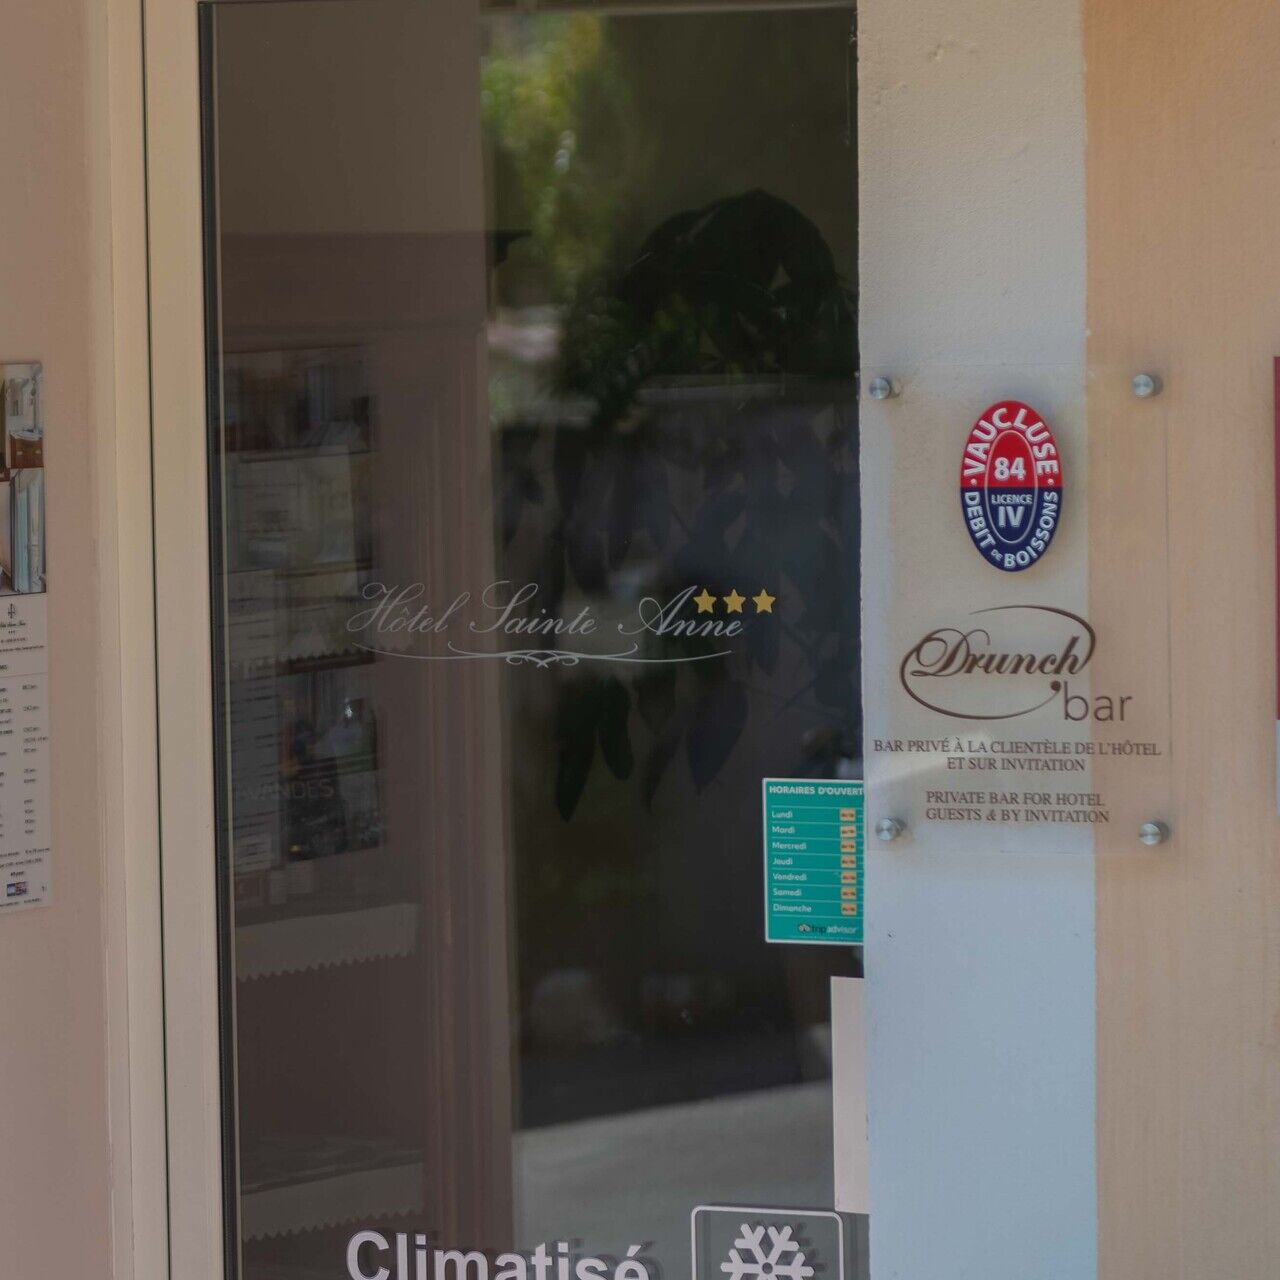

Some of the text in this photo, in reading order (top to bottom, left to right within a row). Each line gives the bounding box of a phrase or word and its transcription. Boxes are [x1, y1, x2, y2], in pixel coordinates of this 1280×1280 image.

[963, 408, 1060, 477] VAUCLUSE
[994, 457, 1027, 481] 84
[991, 494, 1033, 505] LICENCE
[998, 506, 1025, 528] IV
[964, 491, 1059, 569] DEBIT DE BOISSONS
[347, 581, 745, 637] Hôtel Sainte Anne
[910, 628, 1081, 677] Drunch
[1064, 681, 1133, 721] bar
[874, 737, 1161, 756] BAR PRIVÉ À LA CLIENTÈLE DE L'HÔTEL
[947, 757, 1086, 771] ET SUR INVITATION
[769, 786, 815, 795] HORAIRES
[926, 791, 1105, 807] PRIVATE BAR FOR HOTEL
[926, 808, 1110, 823] GUESTS & BY INVITATION
[772, 826, 795, 834] Mardi
[772, 842, 807, 850] Mercredi
[773, 873, 807, 881] Vendredi
[773, 904, 812, 912] Dimanche
